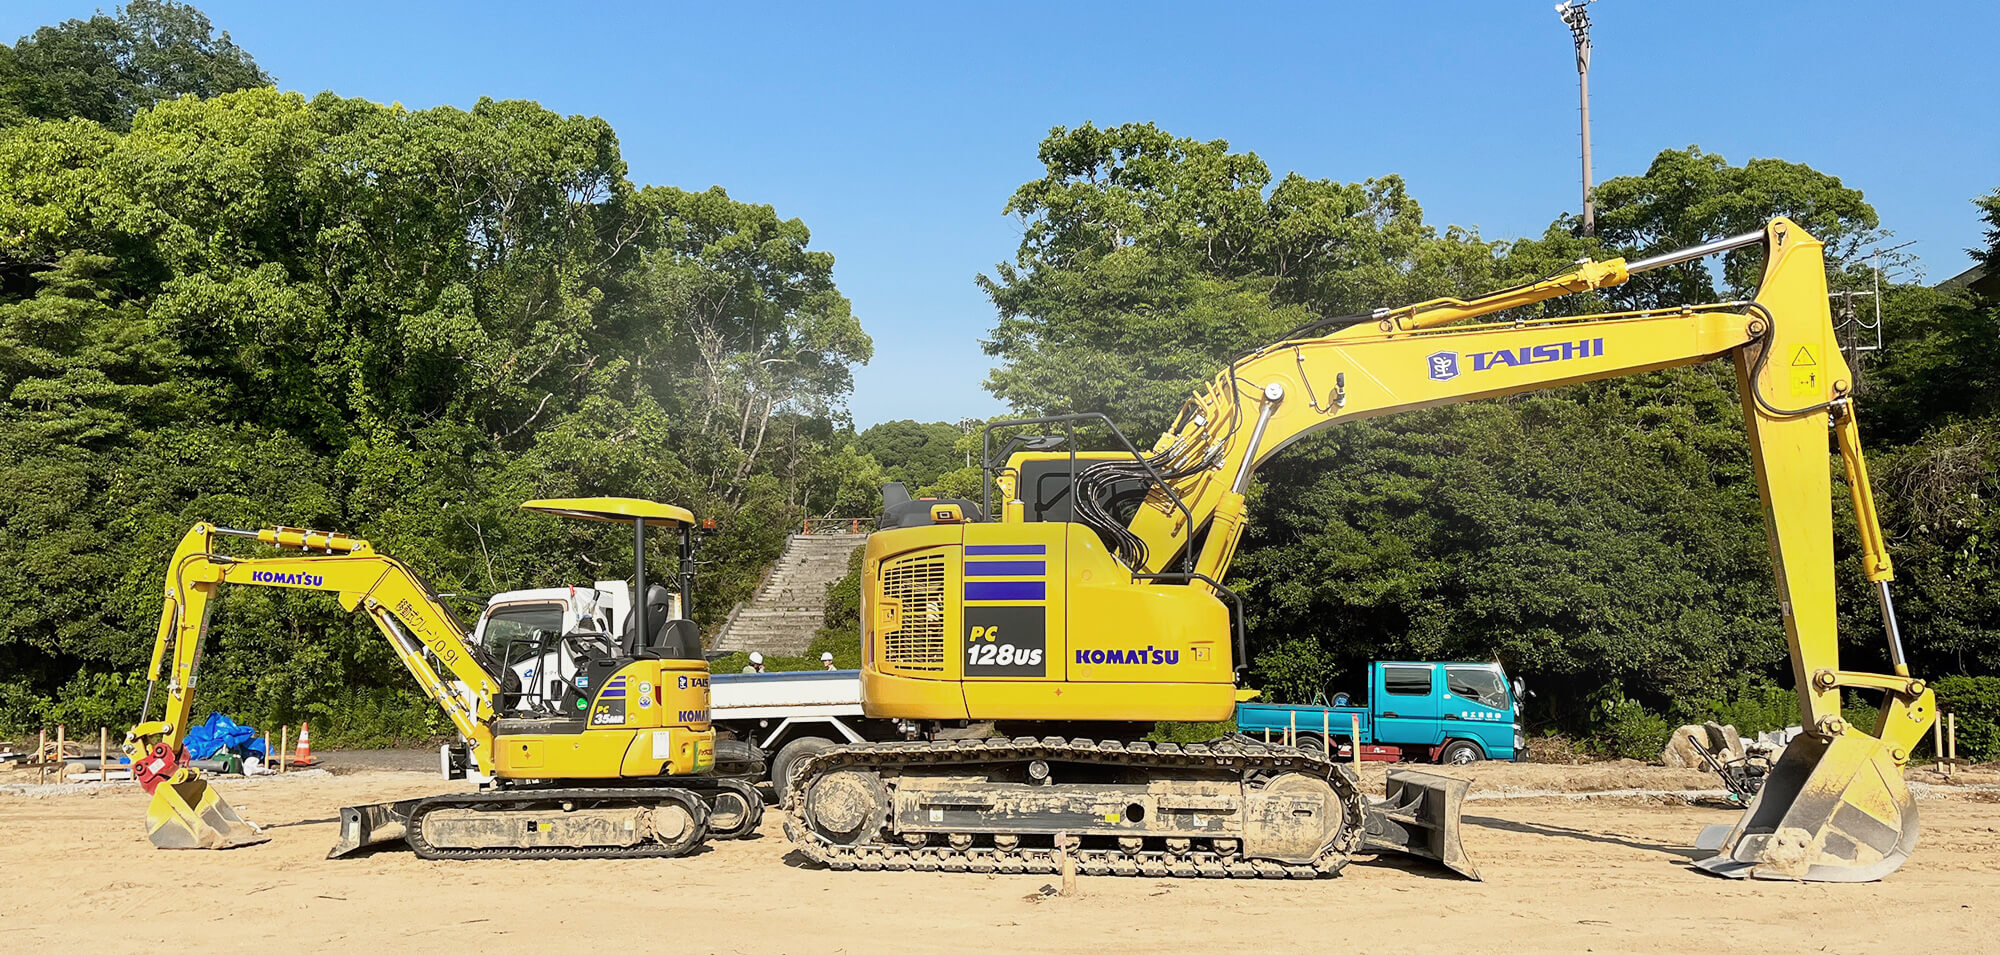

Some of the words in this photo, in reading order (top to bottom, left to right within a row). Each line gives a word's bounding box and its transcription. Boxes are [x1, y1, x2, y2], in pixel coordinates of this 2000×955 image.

[1465, 338, 1604, 372] TAISHI
[252, 571, 323, 587] KOMATSU
[968, 626, 999, 642] PC
[967, 644, 1043, 666] 128US
[1075, 645, 1179, 665] KOMATSU
[596, 705, 610, 714] PC
[594, 713, 625, 724] 35MR
